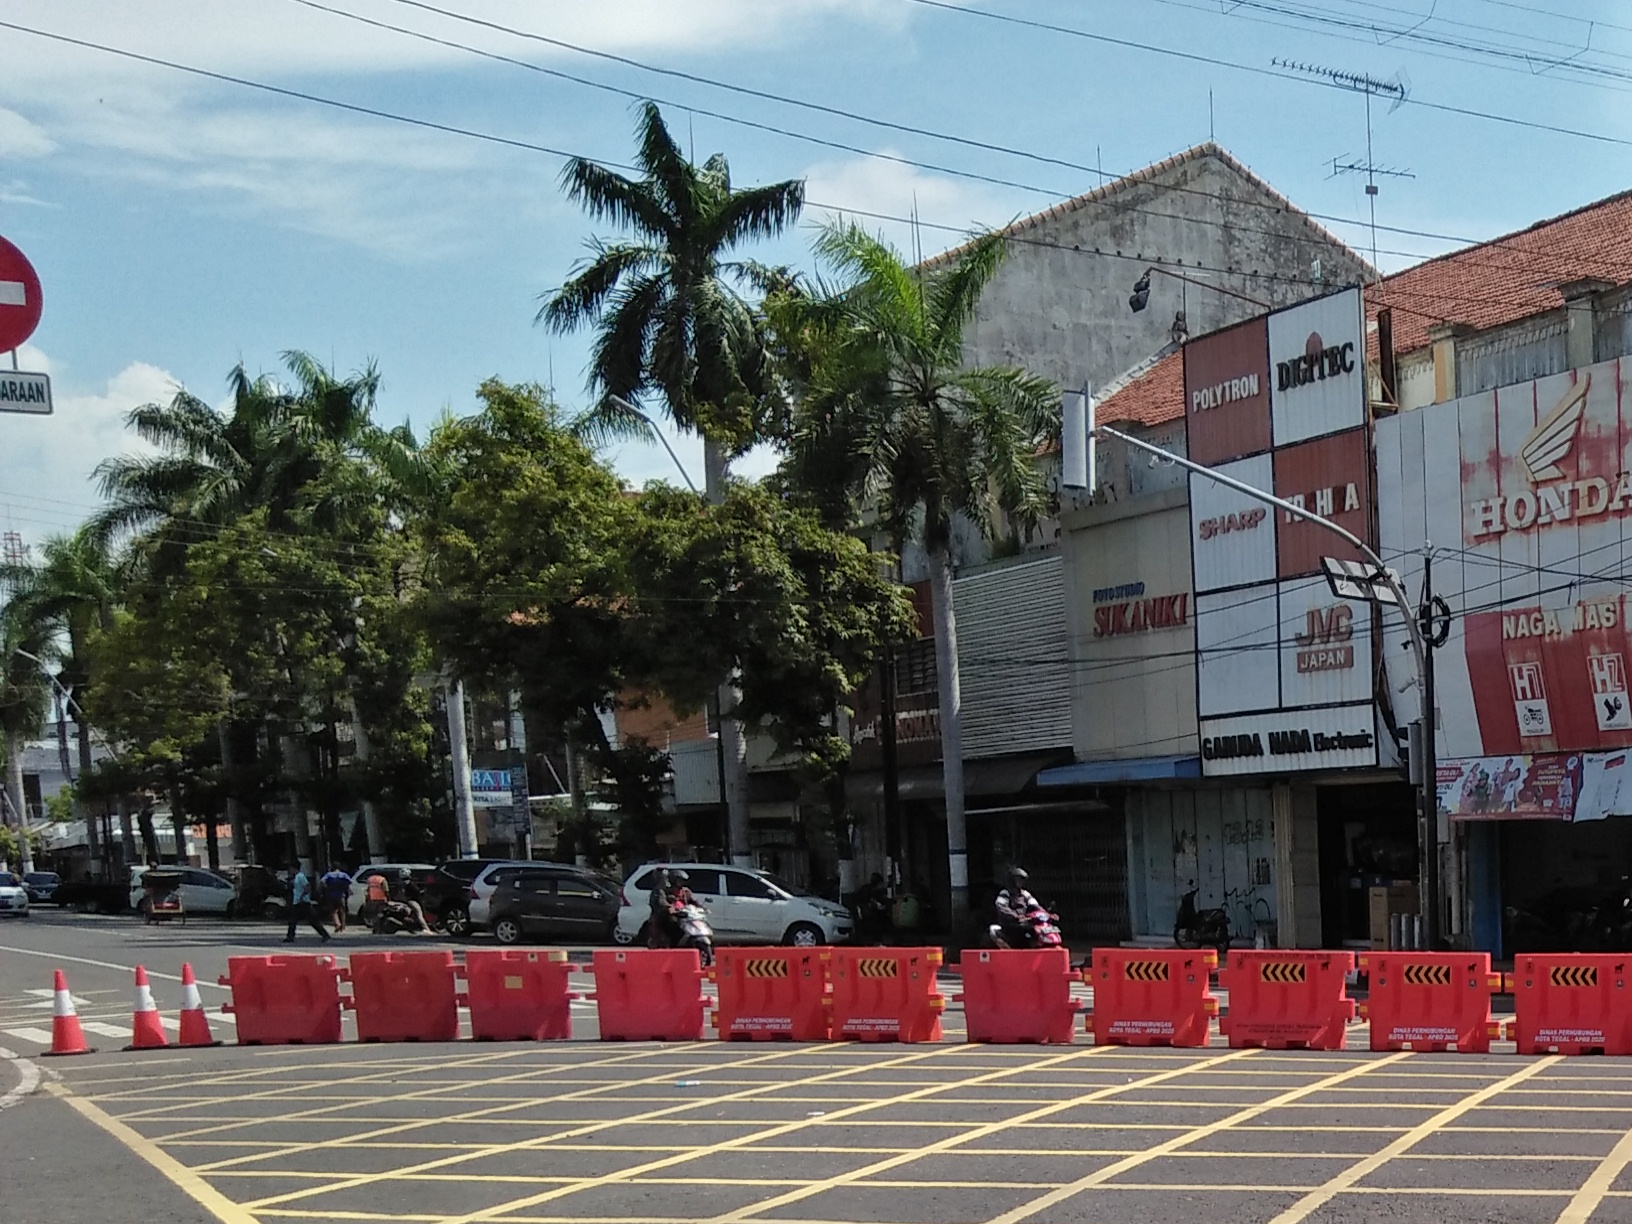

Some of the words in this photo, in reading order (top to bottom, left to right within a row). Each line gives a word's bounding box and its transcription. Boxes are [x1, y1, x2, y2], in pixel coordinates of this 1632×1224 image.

[1277, 341, 1355, 391] DIGITEC
[1192, 373, 1260, 413] POLYTRON
[1199, 508, 1267, 540] SHARP
[1295, 604, 1354, 647] JVC
[1502, 608, 1563, 641] NAGA
[1572, 601, 1618, 633] MAS
[1300, 650, 1345, 669] JAPAN
